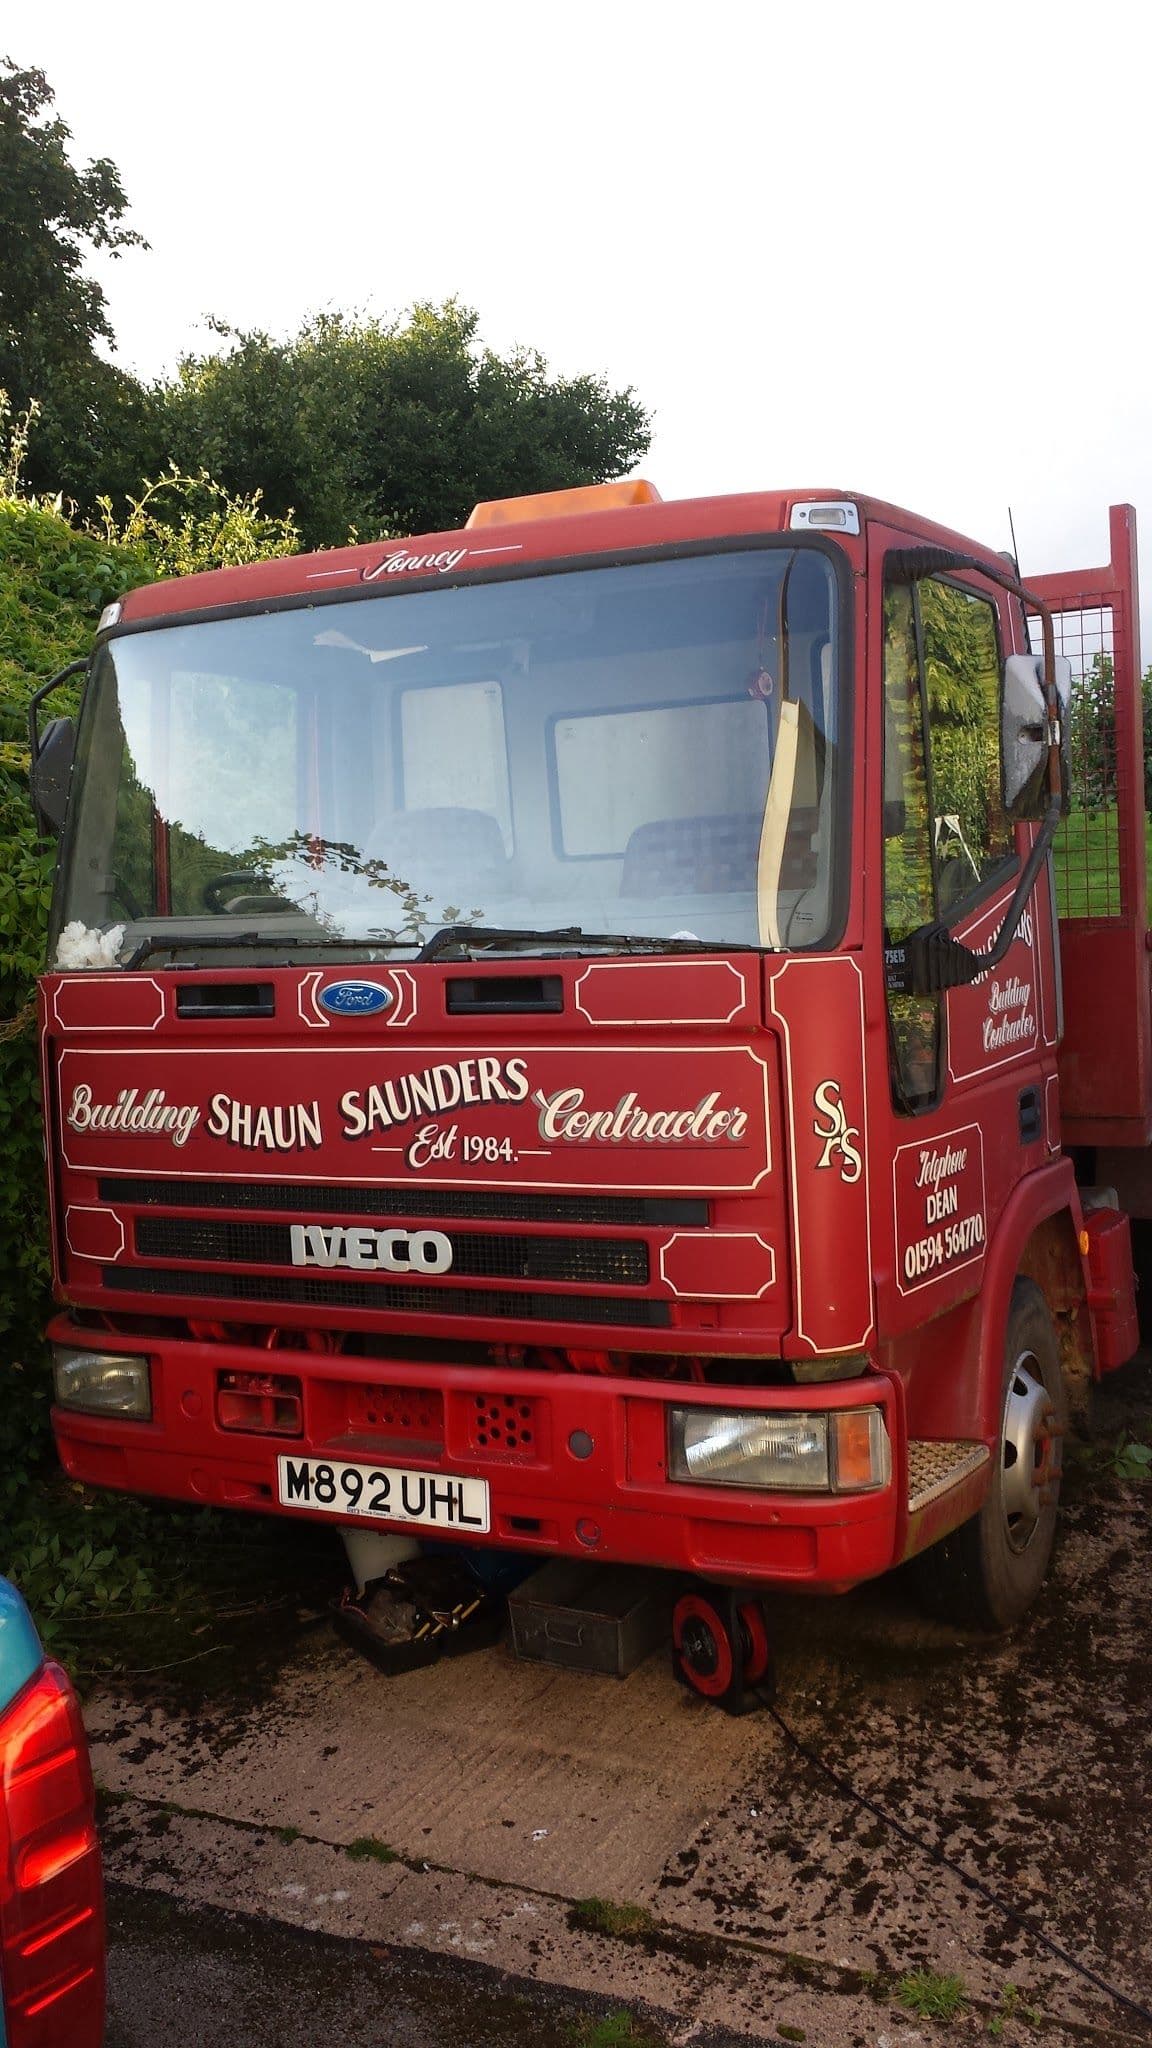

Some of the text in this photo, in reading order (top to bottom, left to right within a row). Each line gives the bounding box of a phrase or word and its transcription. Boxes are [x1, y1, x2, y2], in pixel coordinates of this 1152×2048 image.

[335, 987, 373, 1006] Ford
[992, 976, 1031, 1014] Building
[68, 1057, 748, 1149] Building SHAUN SAUNDERS Contractor
[409, 1123, 459, 1169] Est
[915, 1145, 968, 1193] Telephone
[926, 1184, 959, 1224] DEAN
[290, 1225, 452, 1274] IVECO
[904, 1231, 944, 1279] 01594
[286, 1460, 483, 1526] M892 UHL
